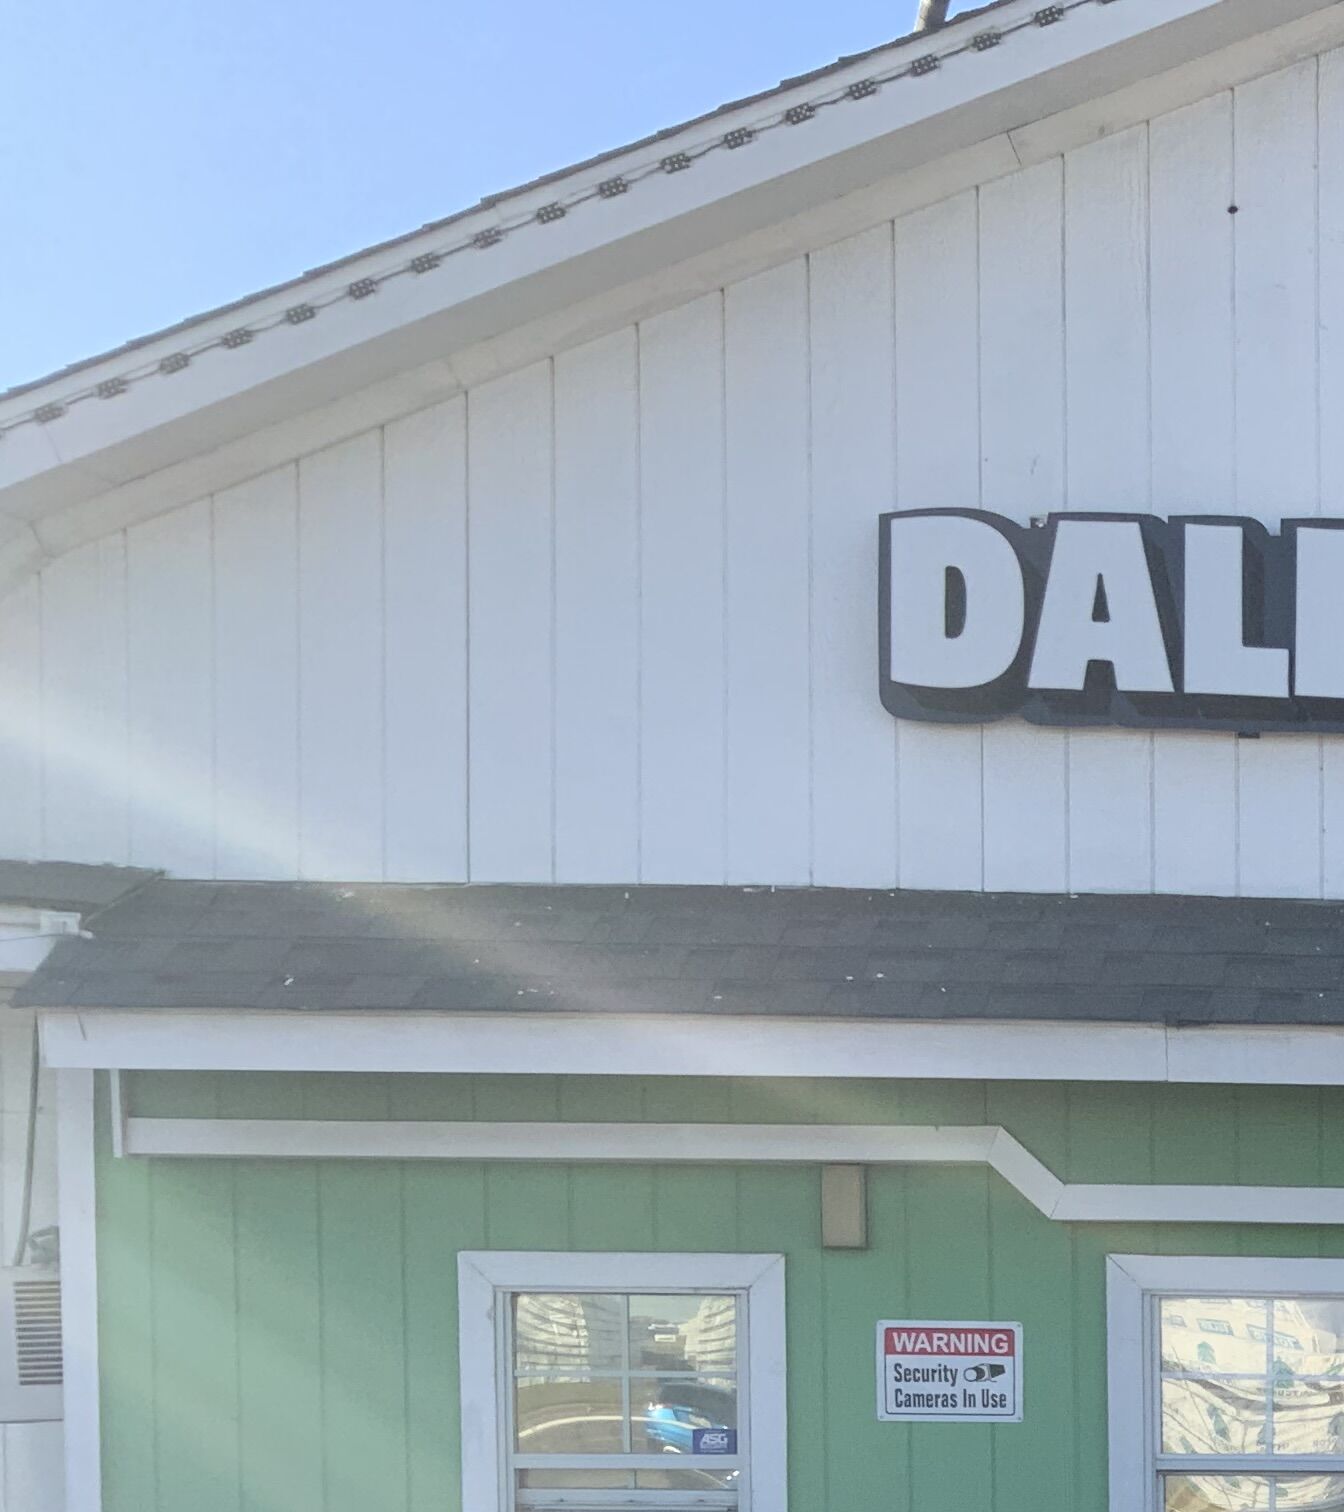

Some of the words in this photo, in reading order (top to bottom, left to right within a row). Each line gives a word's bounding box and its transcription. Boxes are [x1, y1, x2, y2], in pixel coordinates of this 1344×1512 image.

[892, 1331, 1009, 1354] WARNING
[893, 1362, 959, 1387] Security
[894, 1388, 958, 1408] Cameras
[963, 1388, 977, 1408] In
[981, 1388, 1007, 1408] Use
